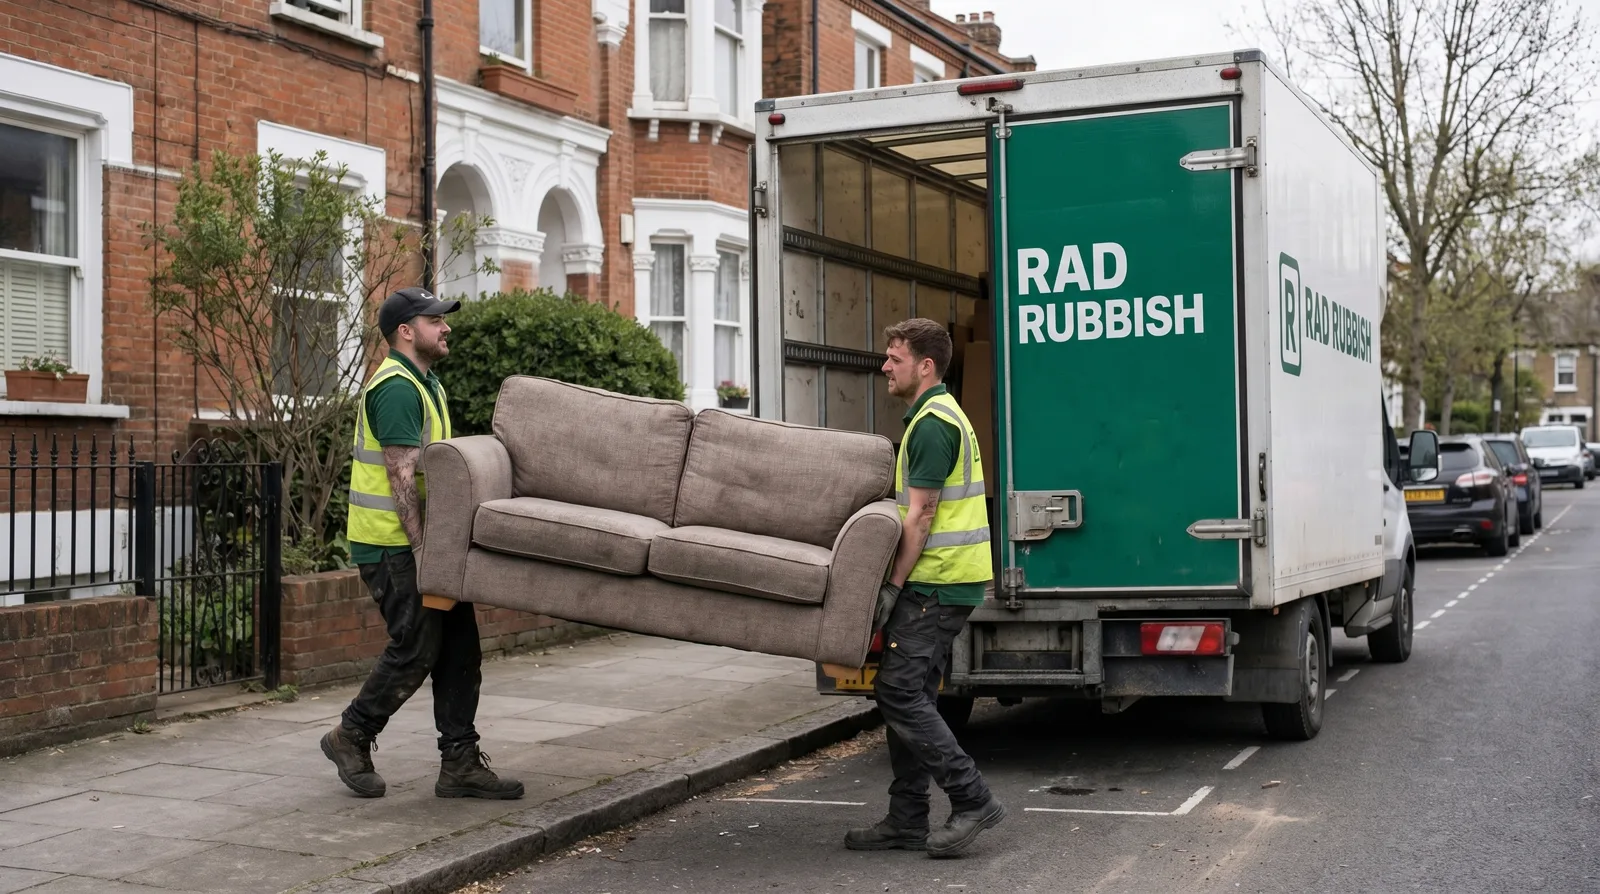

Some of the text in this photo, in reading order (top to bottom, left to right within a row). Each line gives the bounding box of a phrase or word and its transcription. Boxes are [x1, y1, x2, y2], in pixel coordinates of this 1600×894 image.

[1017, 242, 1128, 295] RAD
[1018, 293, 1205, 344] RUBBISH
[1284, 278, 1297, 353] R
[1305, 286, 1372, 364] RAD RUBBISH
